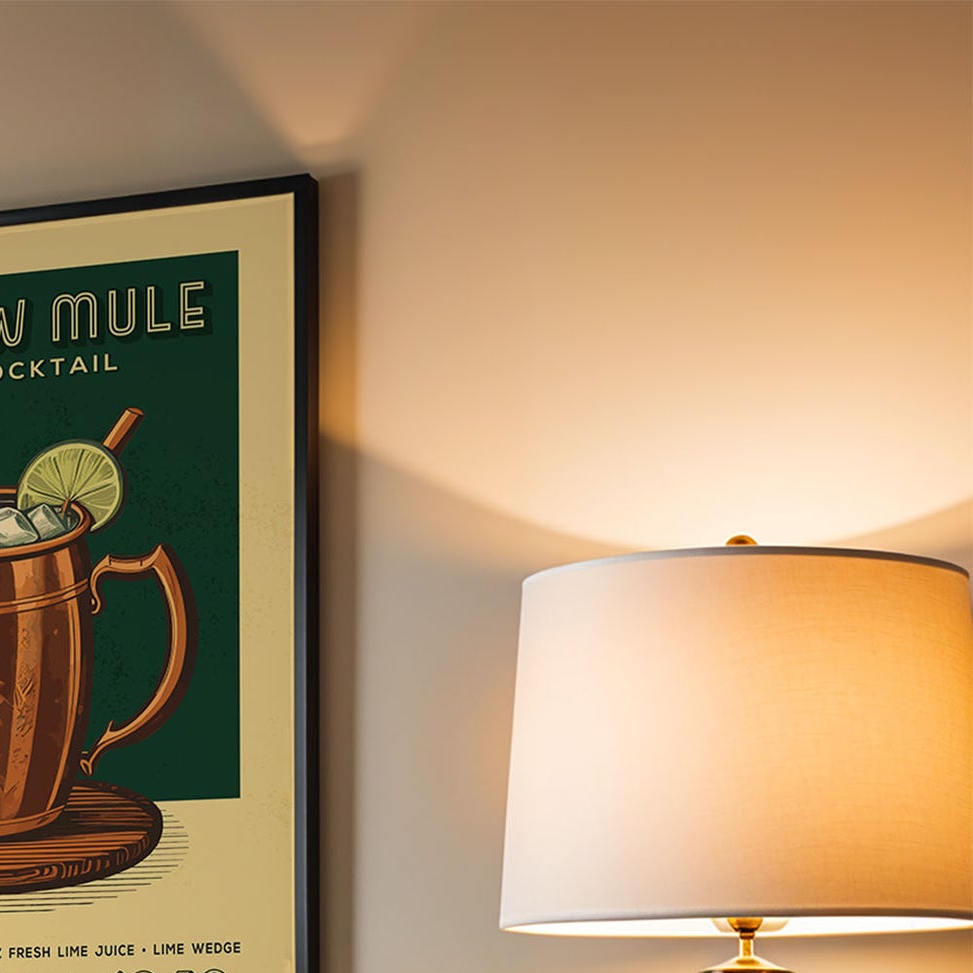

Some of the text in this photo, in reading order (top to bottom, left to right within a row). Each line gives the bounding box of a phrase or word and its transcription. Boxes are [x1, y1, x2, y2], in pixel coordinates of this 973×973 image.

[52, 281, 209, 344] MULE
[8, 946, 51, 958] FRESH
[57, 945, 88, 957] LIME
[95, 944, 135, 957] JUICE
[153, 943, 184, 955] LIME
[192, 942, 241, 955] WEDGE
